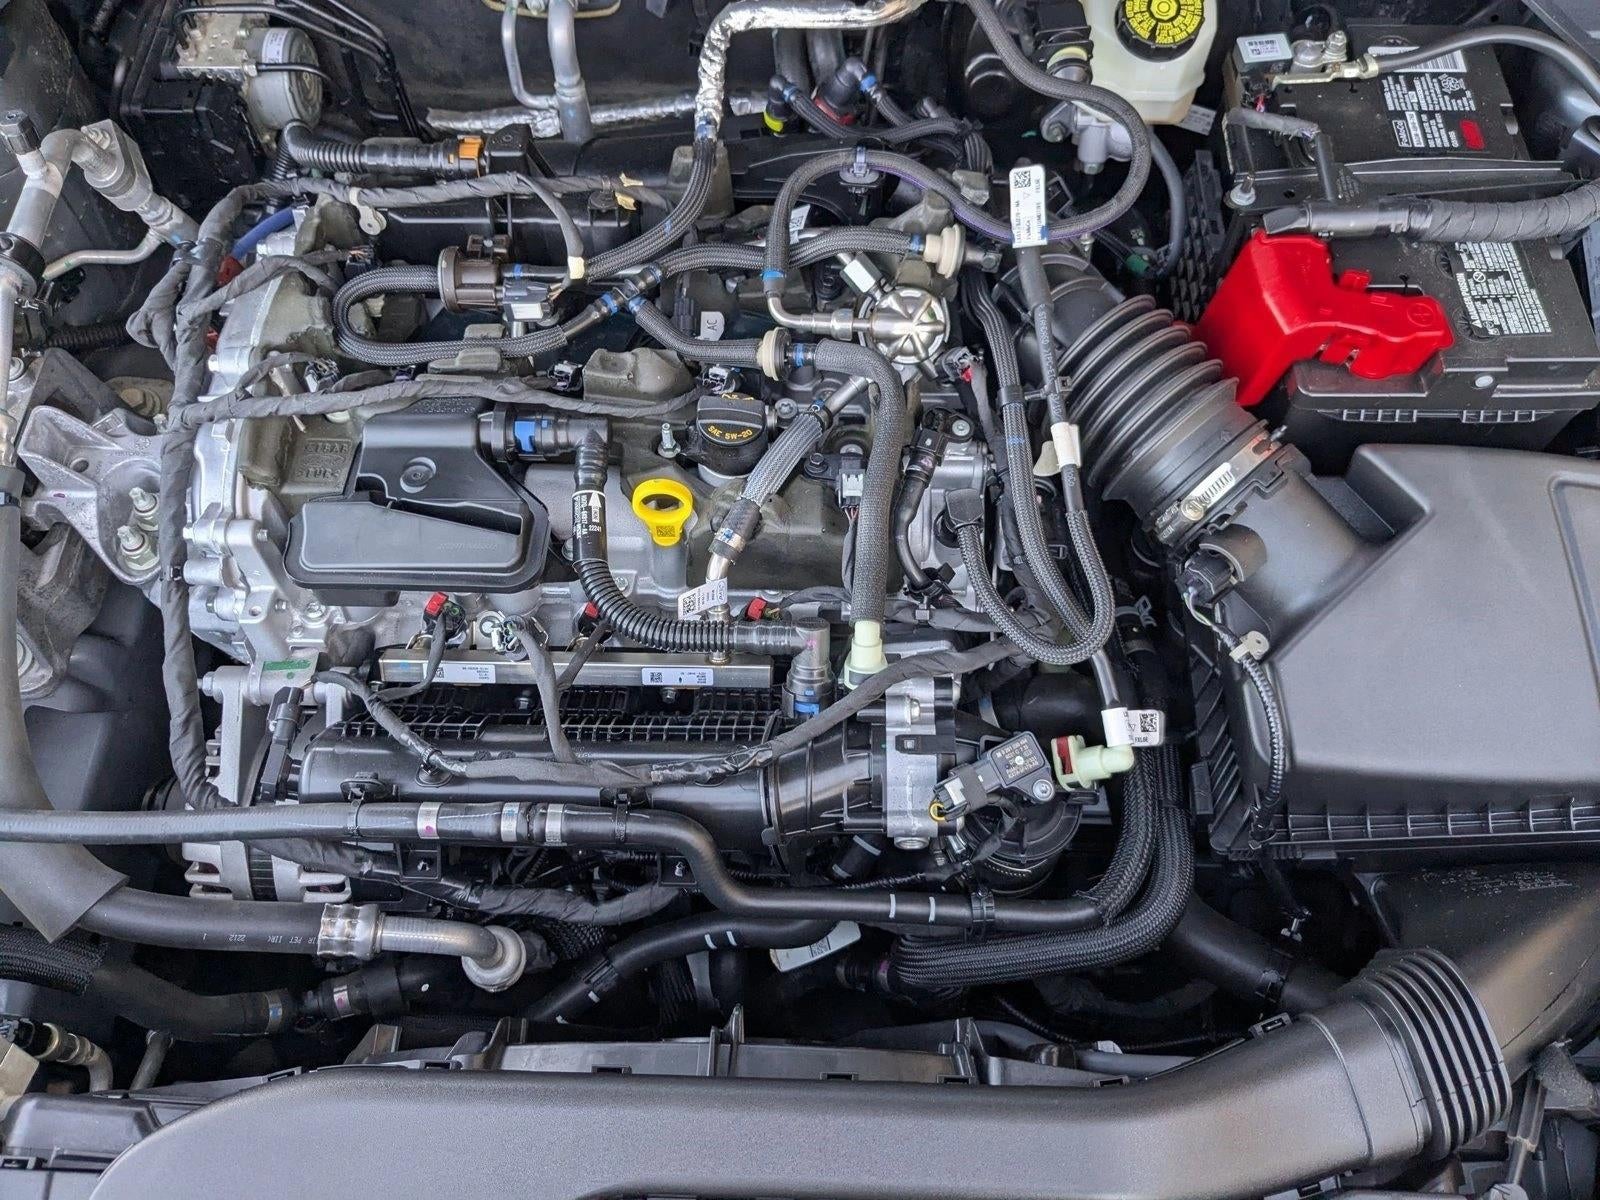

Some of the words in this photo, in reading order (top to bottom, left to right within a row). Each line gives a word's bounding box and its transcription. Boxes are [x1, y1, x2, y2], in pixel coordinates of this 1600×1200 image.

[706, 319, 718, 331] AC
[708, 425, 723, 437] SAE
[724, 429, 753, 440] 5W-20
